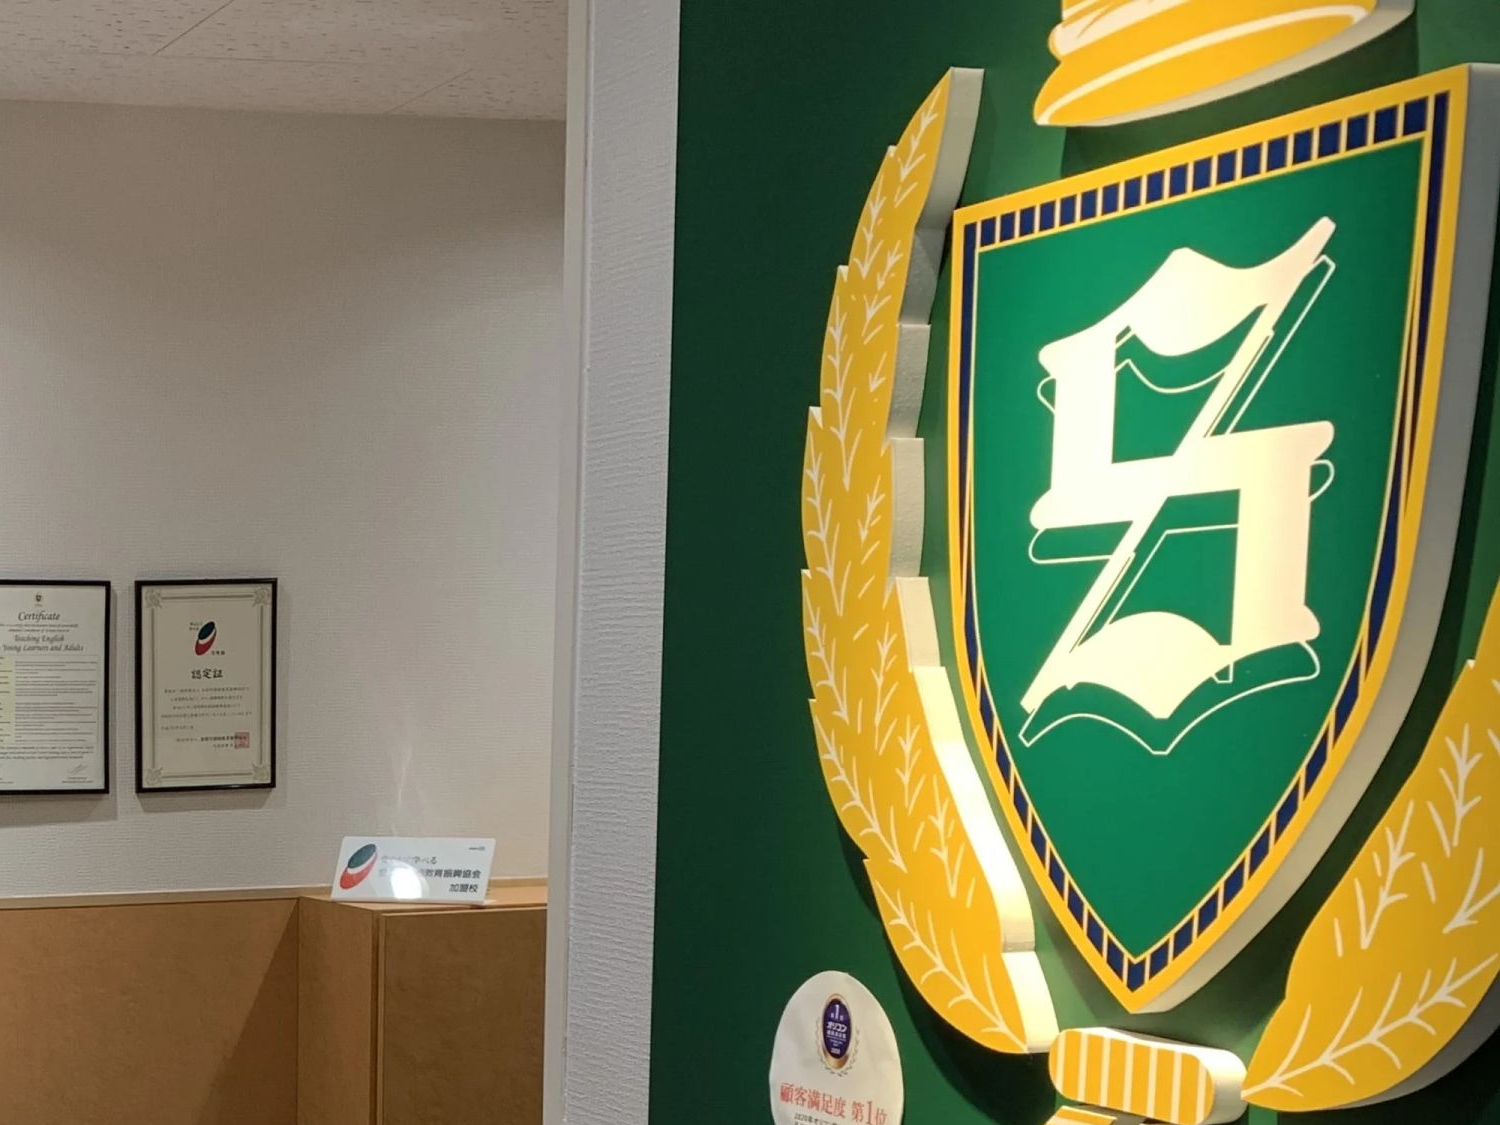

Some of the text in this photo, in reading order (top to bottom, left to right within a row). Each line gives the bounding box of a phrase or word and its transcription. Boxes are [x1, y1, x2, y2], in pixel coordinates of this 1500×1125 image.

[17, 611, 61, 623] Certificate
[13, 634, 65, 645] Teaching English
[2, 643, 22, 654] Young
[22, 643, 49, 652] Learners
[49, 643, 63, 652] and
[64, 643, 84, 652] Adults
[449, 883, 479, 893] 加盟校
[779, 1081, 847, 1119] 顧客満足度
